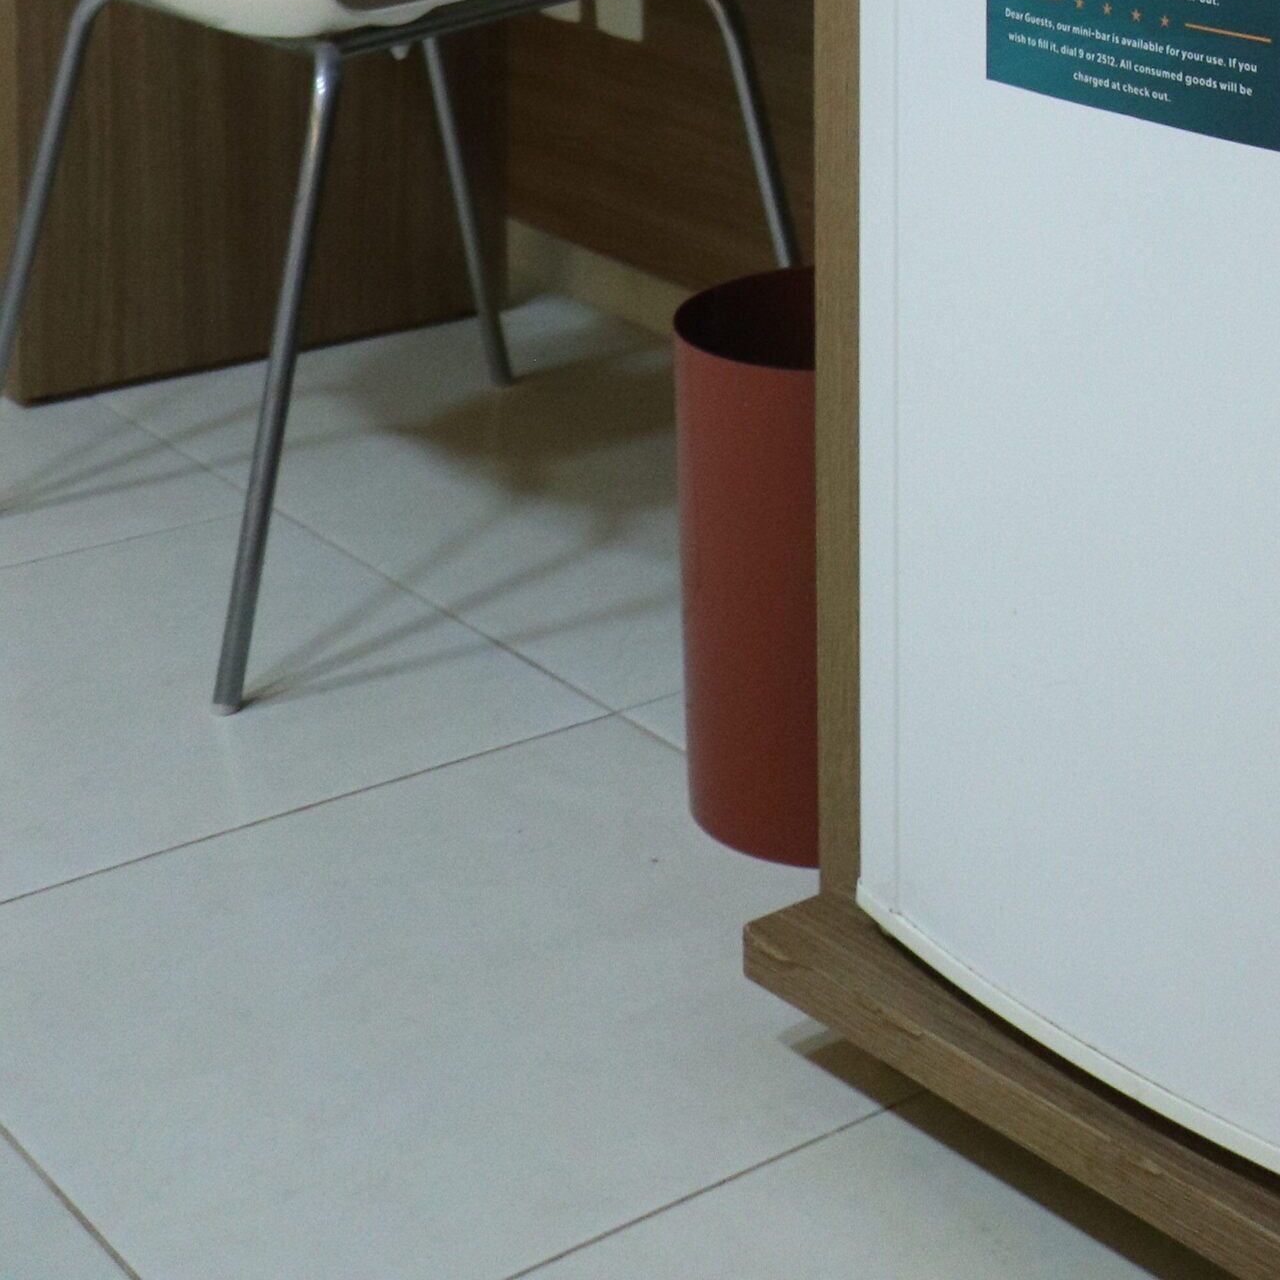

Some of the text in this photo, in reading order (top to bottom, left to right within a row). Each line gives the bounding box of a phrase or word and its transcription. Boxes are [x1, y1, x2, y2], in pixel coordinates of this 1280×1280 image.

[1004, 6, 1257, 73] Dear Guests, our mini-bar is available for your use. If you
[1008, 32, 1026, 44] wish
[1027, 36, 1036, 46] to
[1060, 44, 1077, 56] dial
[1078, 48, 1084, 58] 9
[1085, 52, 1095, 61] or
[1119, 58, 1132, 70] All
[1133, 63, 1183, 82] consumed
[1184, 74, 1217, 88] goods
[1218, 81, 1237, 93] will
[1238, 83, 1252, 96] be
[1072, 71, 1171, 102] charged at check out.
